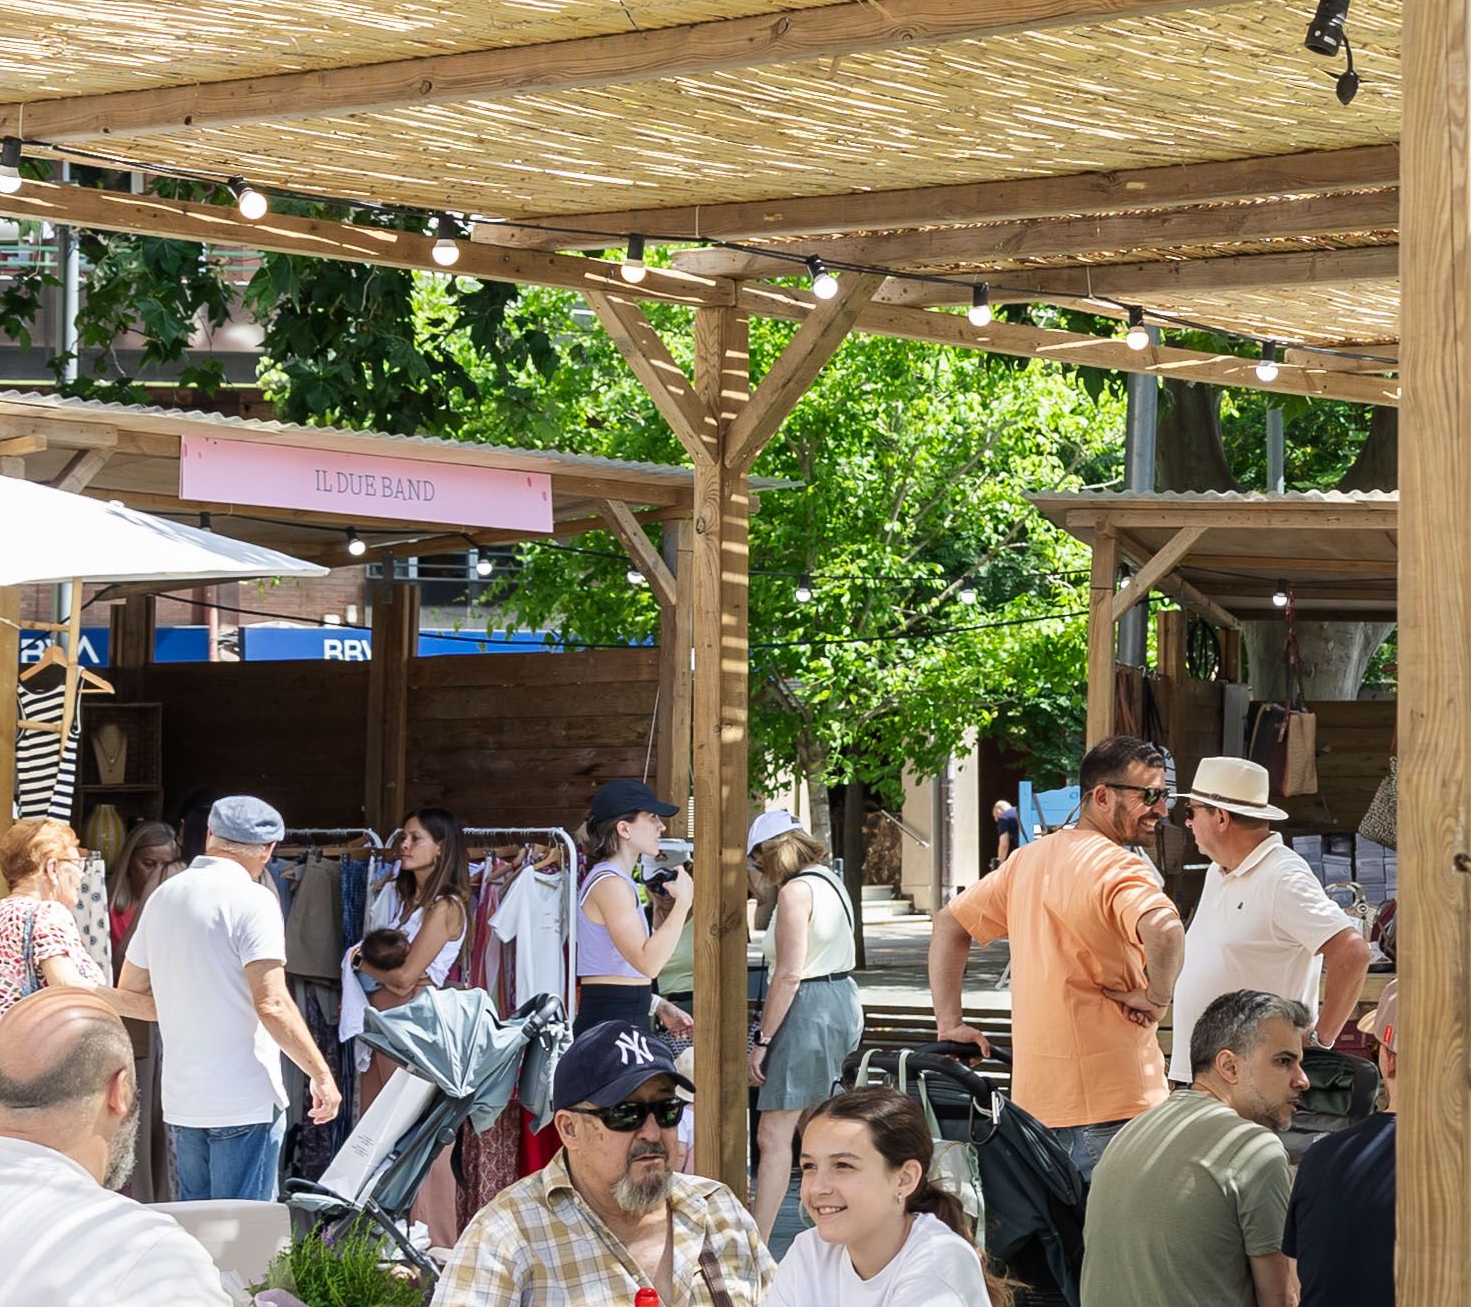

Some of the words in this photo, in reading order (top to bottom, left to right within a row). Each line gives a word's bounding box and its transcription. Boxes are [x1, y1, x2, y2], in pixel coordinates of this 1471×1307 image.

[314, 469, 333, 493] IL
[336, 471, 377, 497] DUE
[380, 476, 436, 502] BAND
